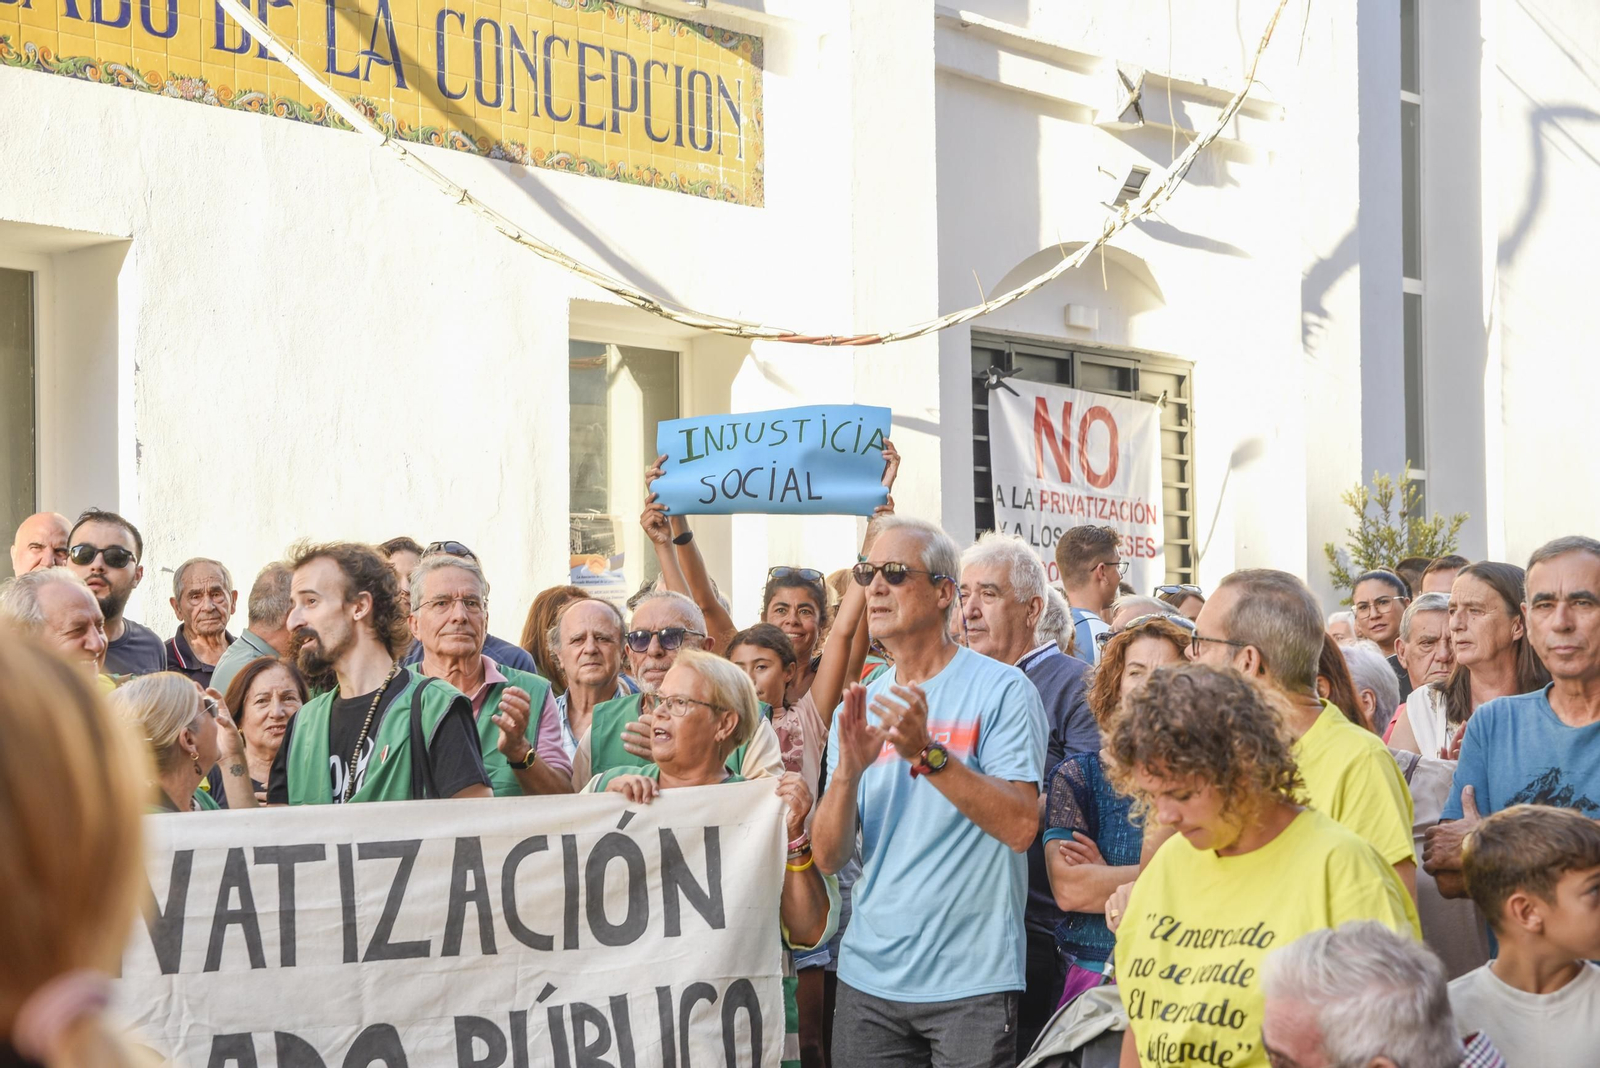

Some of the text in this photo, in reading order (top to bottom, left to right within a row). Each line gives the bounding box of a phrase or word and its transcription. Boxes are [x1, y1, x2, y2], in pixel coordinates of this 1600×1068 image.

[323, 0, 409, 90] LA
[435, 7, 745, 161] CONCEPCION
[678, 413, 886, 464] INJUSTICIA
[1033, 396, 1119, 489] NO
[699, 460, 823, 504] SOCIAL
[995, 484, 1157, 526] A LA PRIVATIZACIÓN
[1030, 524, 1063, 548] LOS
[138, 810, 726, 977] VATIZACIÓN
[1175, 921, 1276, 949] mercado
[1128, 957, 1156, 979] no
[1158, 963, 1192, 985] se
[1128, 988, 1146, 1020] El
